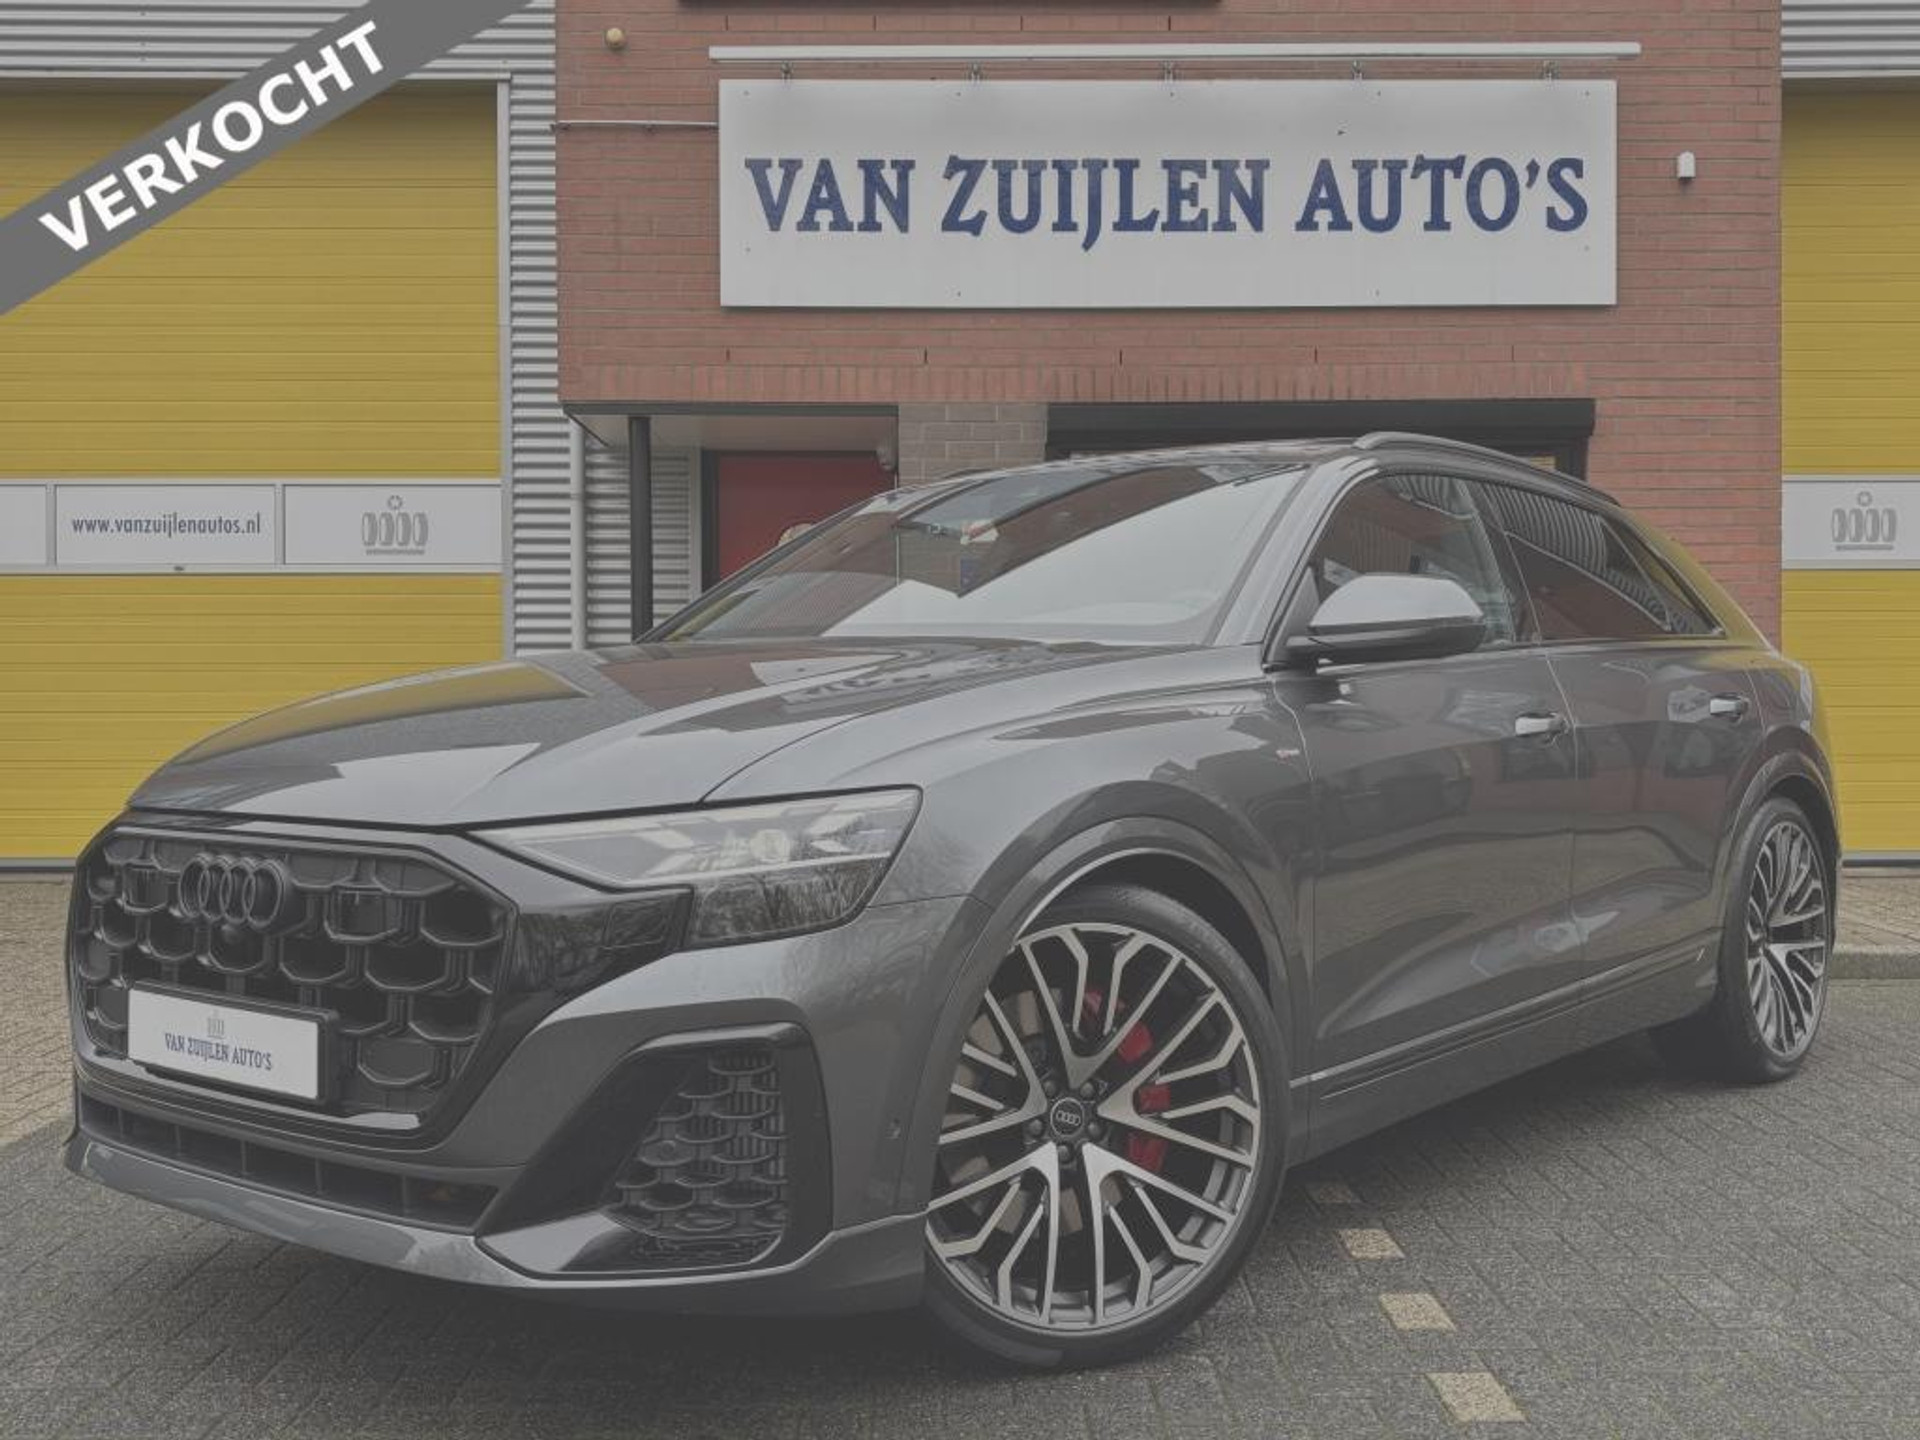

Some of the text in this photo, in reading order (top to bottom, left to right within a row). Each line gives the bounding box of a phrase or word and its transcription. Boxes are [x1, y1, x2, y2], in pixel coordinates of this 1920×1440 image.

[745, 154, 1590, 251] VAN ZUIJLEN AUTO'S
[72, 511, 261, 538] www.vanzuijlenautos.nl
[164, 1032, 272, 1071] VAN ZUIJLEN AUTO'S
